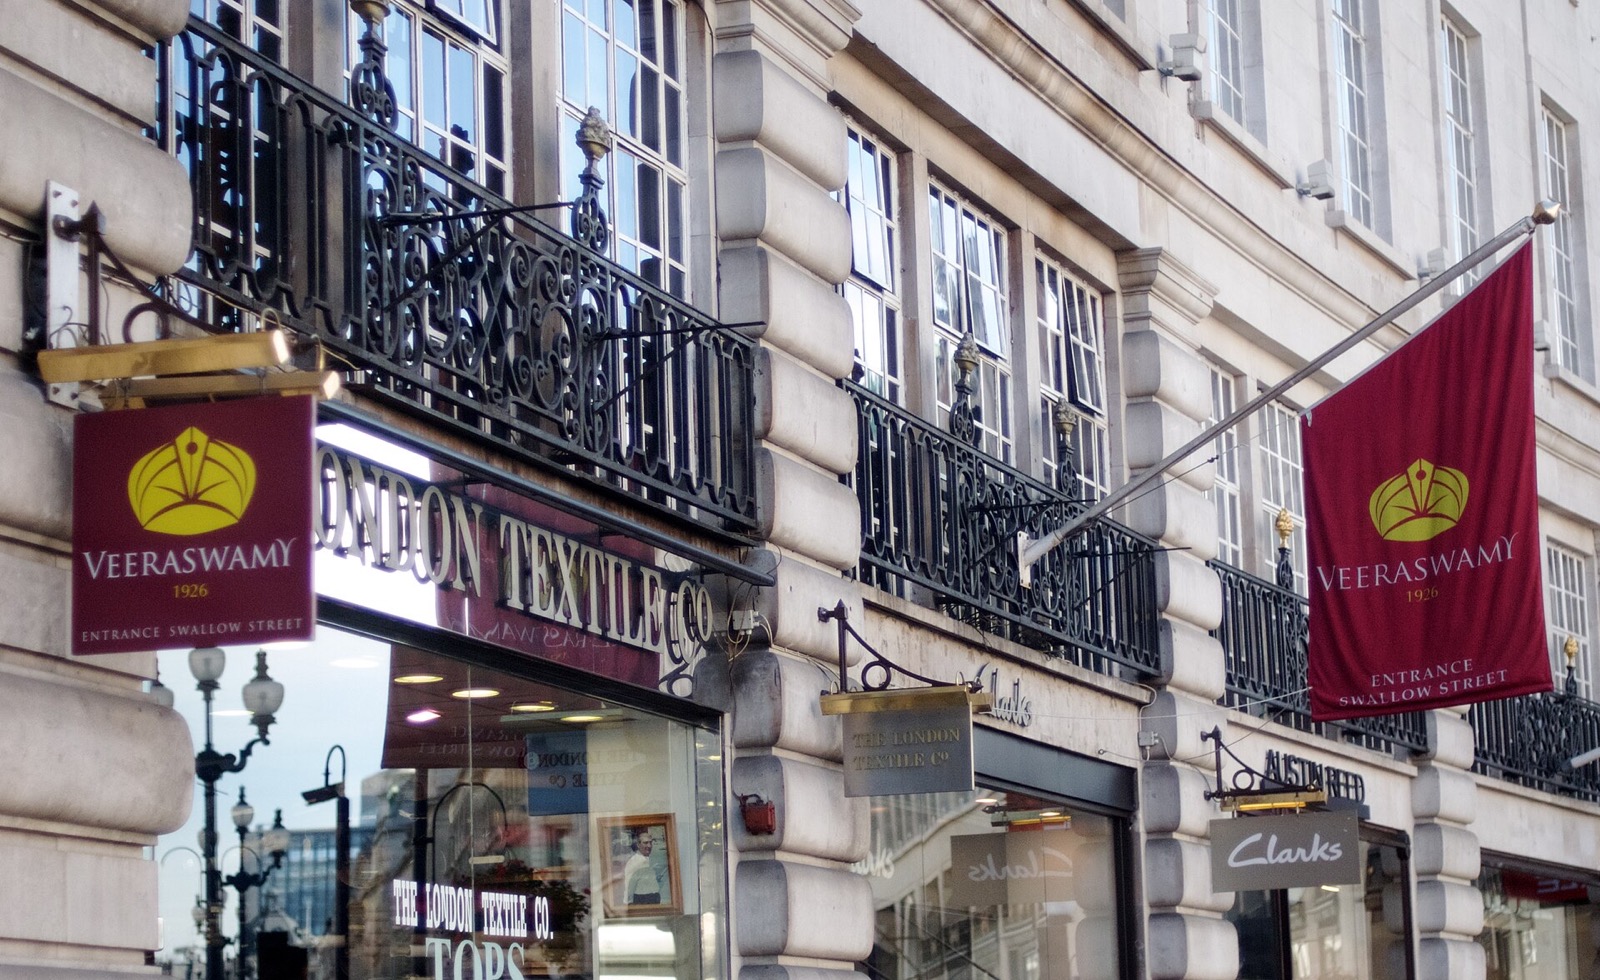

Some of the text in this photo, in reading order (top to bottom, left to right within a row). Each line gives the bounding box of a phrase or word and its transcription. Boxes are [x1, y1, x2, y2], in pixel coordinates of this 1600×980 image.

[82, 537, 297, 580] VEERASWAMY
[314, 446, 483, 597] ONDON
[500, 513, 665, 655] TEXTILE
[1316, 531, 1520, 592] VEERASWAMY
[173, 583, 209, 599] 1926
[1407, 586, 1439, 603] 1926
[81, 617, 304, 643] ENTRANCE SWALLOW STREET
[1338, 669, 1509, 707] SWALLOW STREET
[1370, 657, 1474, 688] ENTRANCE
[854, 728, 960, 748] THE LONDON
[853, 752, 926, 771] TEXTILE
[1264, 749, 1366, 806] AUSTIN REED
[1227, 832, 1343, 869] Clarks
[393, 879, 554, 940] THE LONDON TEXTILE CO.
[425, 937, 525, 980] TOPS
